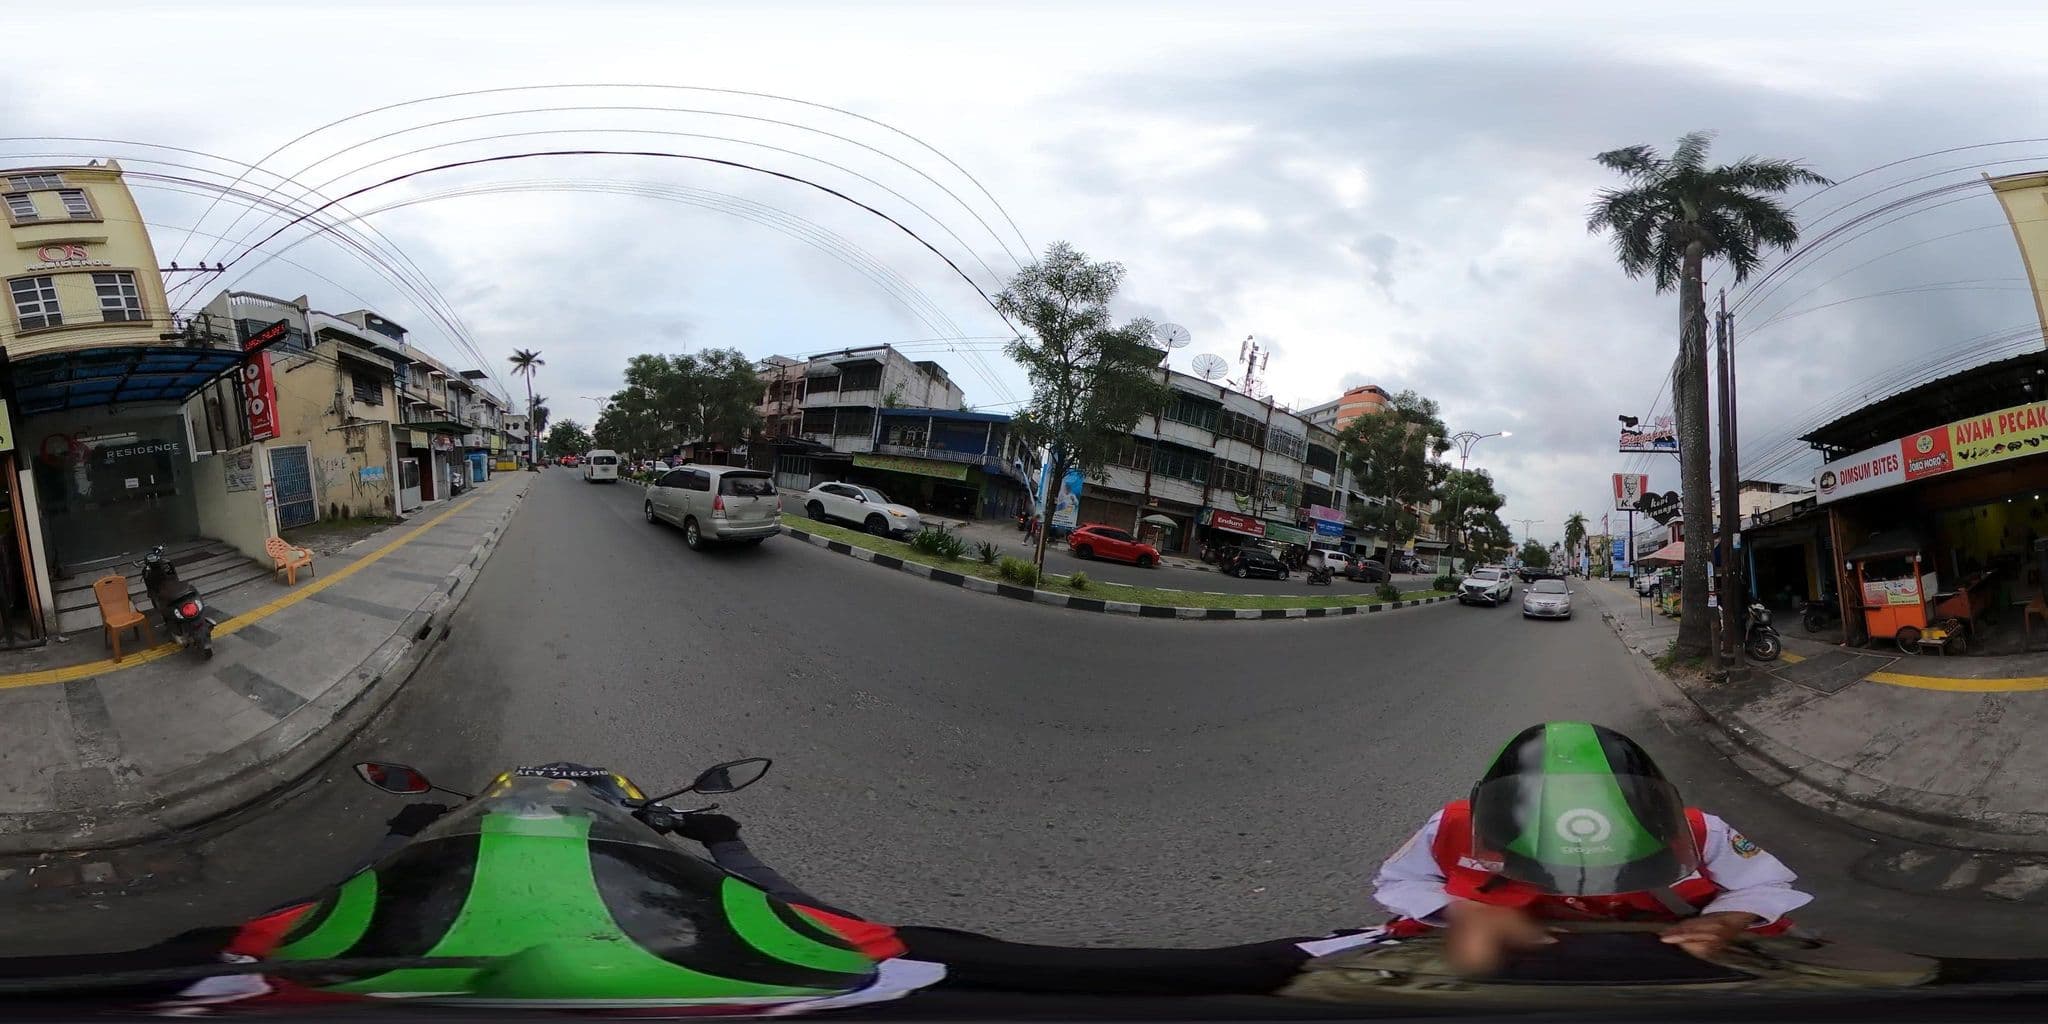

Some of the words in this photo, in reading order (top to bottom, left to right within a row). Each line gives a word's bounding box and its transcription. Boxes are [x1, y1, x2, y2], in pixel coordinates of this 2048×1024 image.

[246, 363, 265, 416] OYO
[1956, 418, 1995, 445] AYAM
[1998, 406, 2048, 435] PECAK
[106, 442, 179, 459] RESIDENCE
[1840, 462, 1871, 486] DIMSUM
[1872, 454, 1899, 477] BITES
[1217, 517, 1243, 528] Enduro
